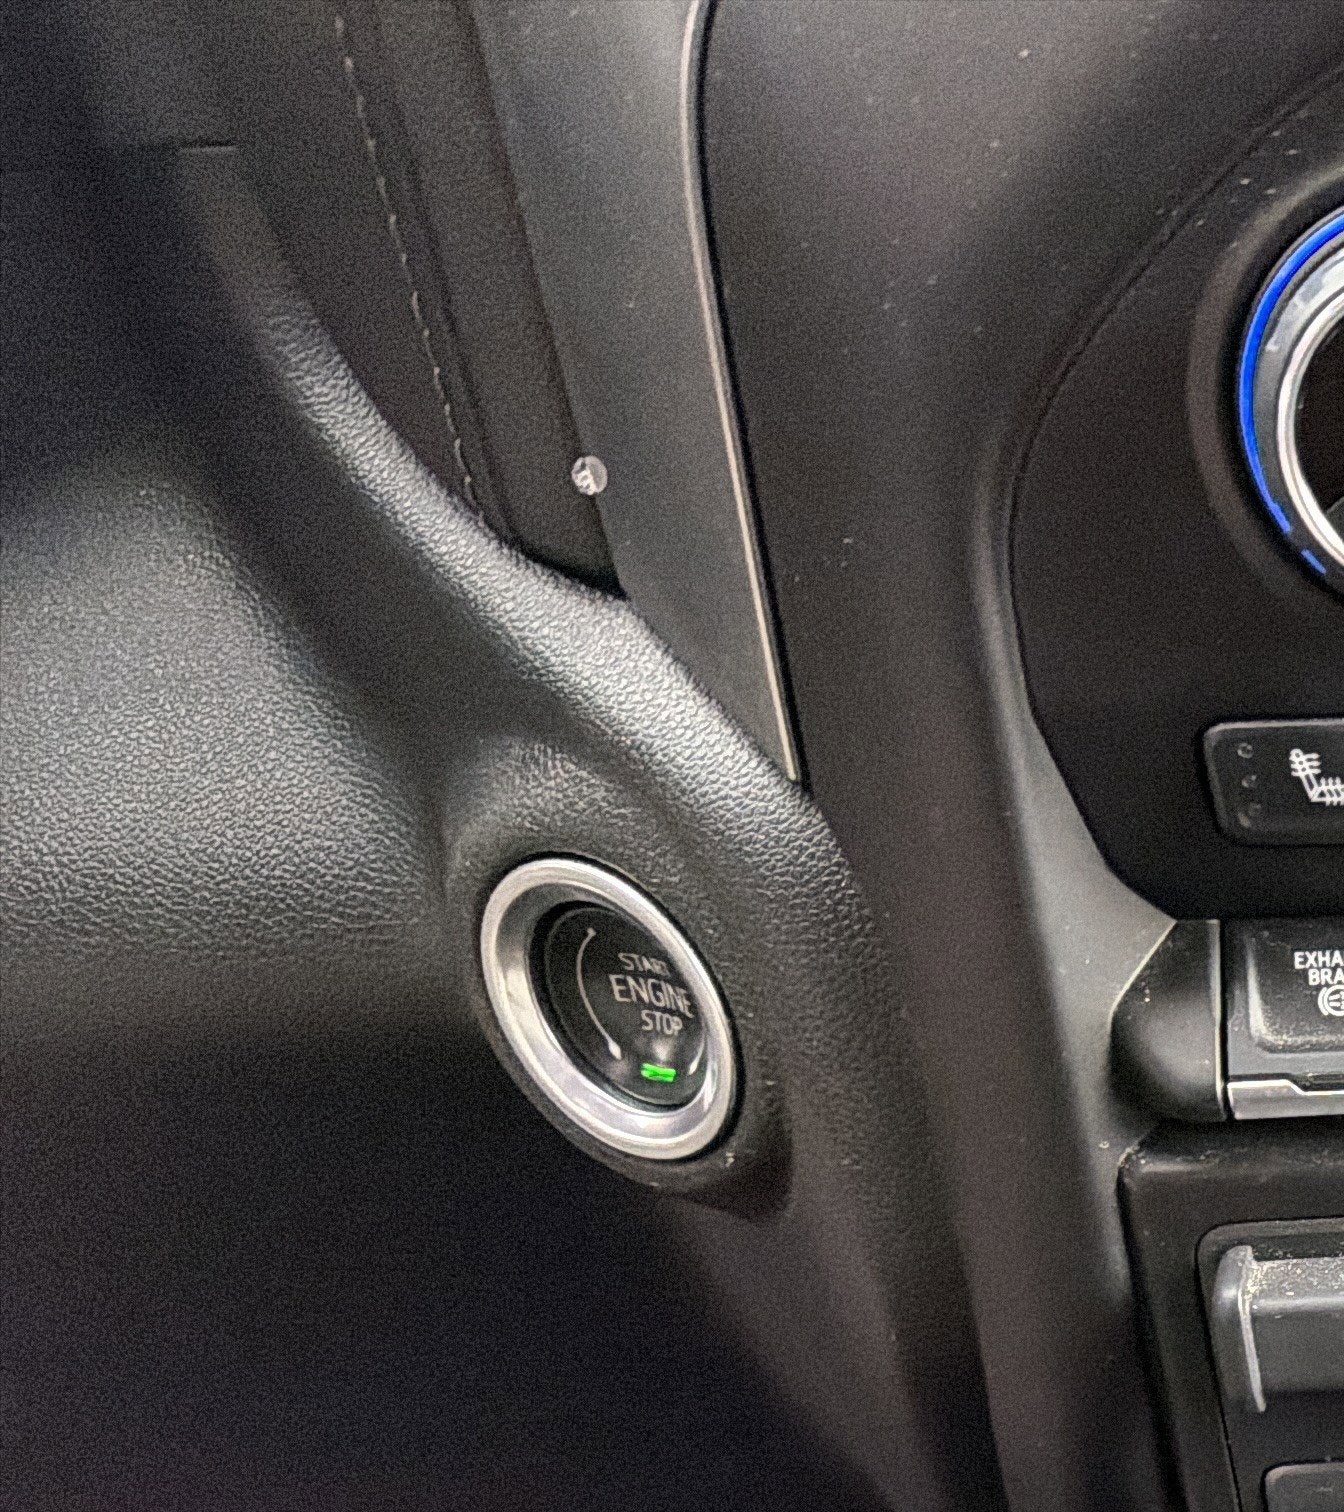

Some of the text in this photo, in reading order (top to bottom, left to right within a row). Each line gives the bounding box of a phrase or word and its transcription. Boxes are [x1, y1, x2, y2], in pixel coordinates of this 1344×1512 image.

[617, 951, 671, 978] START
[608, 973, 694, 1019] ENGINE
[640, 1009, 684, 1037] STOP
